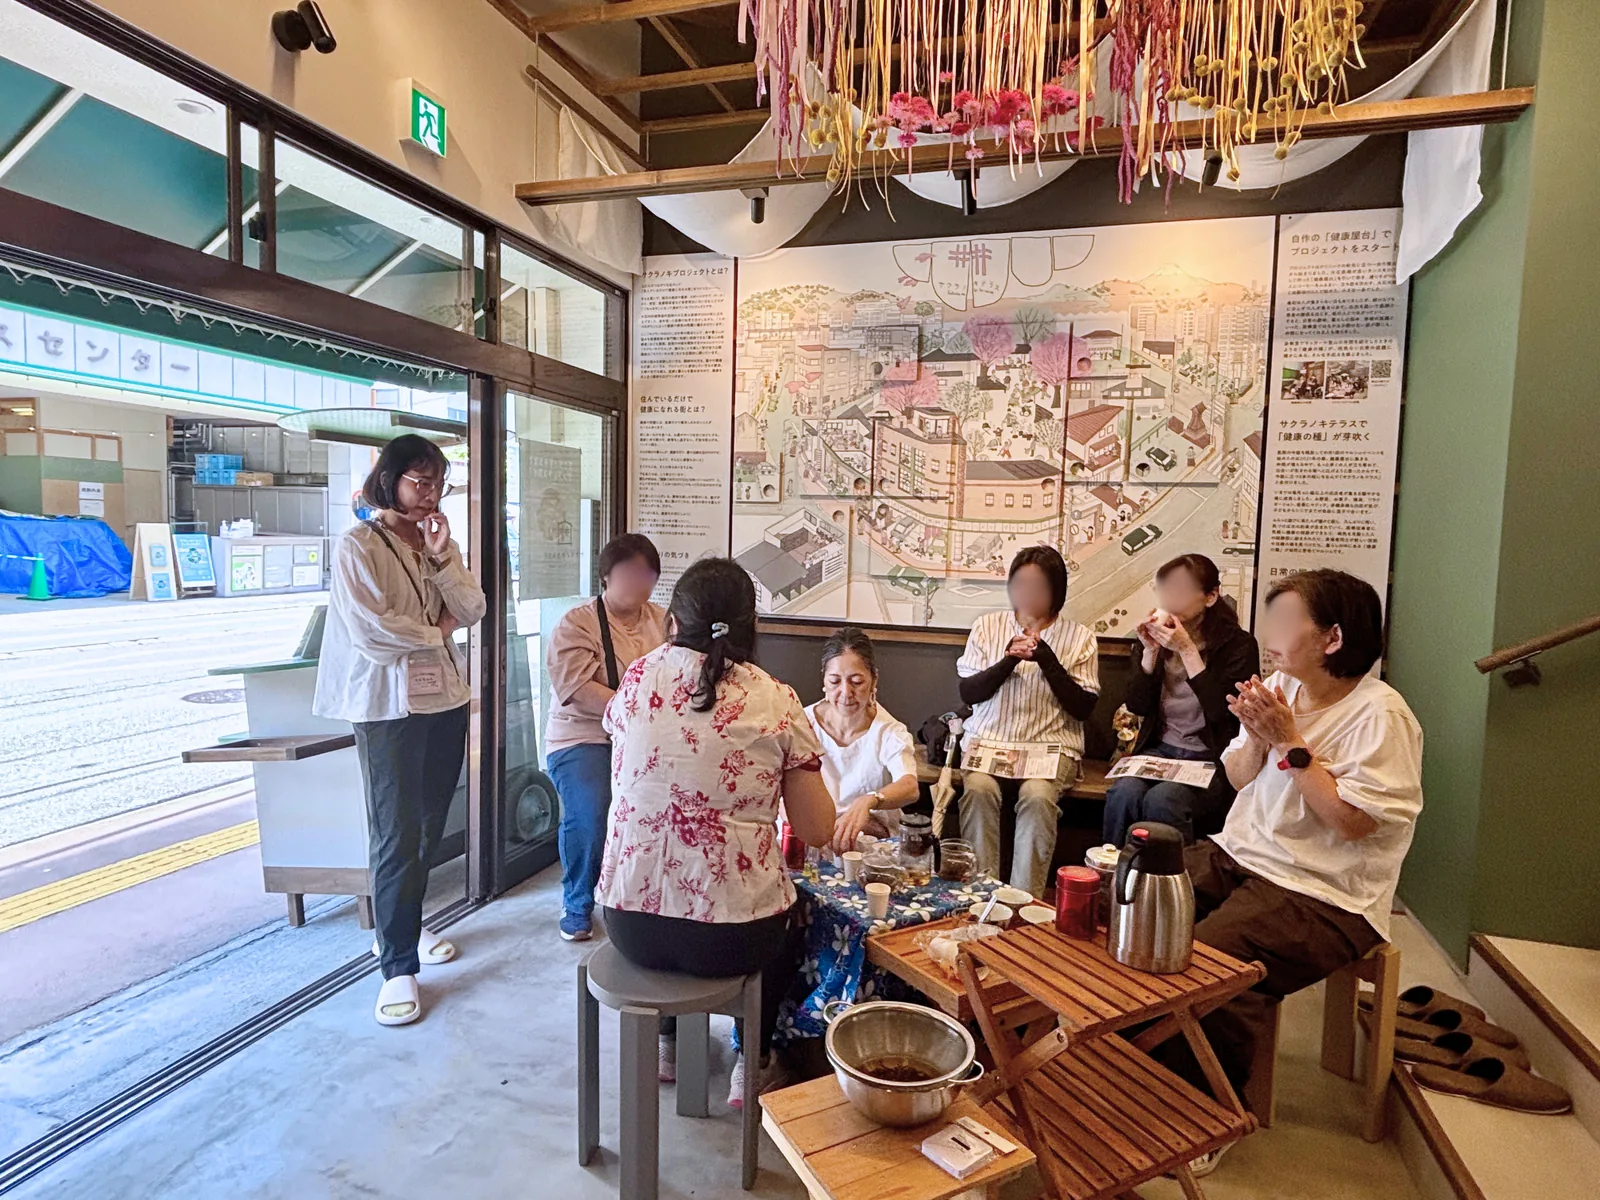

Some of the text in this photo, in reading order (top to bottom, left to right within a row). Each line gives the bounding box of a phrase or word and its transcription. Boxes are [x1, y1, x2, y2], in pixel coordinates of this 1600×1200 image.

[1291, 230, 1392, 243] 自作の「健康屋台」で
[1291, 242, 1399, 255] プロジェクトをスタート
[640, 395, 693, 403] 住んでいるだけで
[1280, 419, 1368, 428] サクラノキテラスで
[1278, 432, 1370, 441] 「健康の種」が芽吹く
